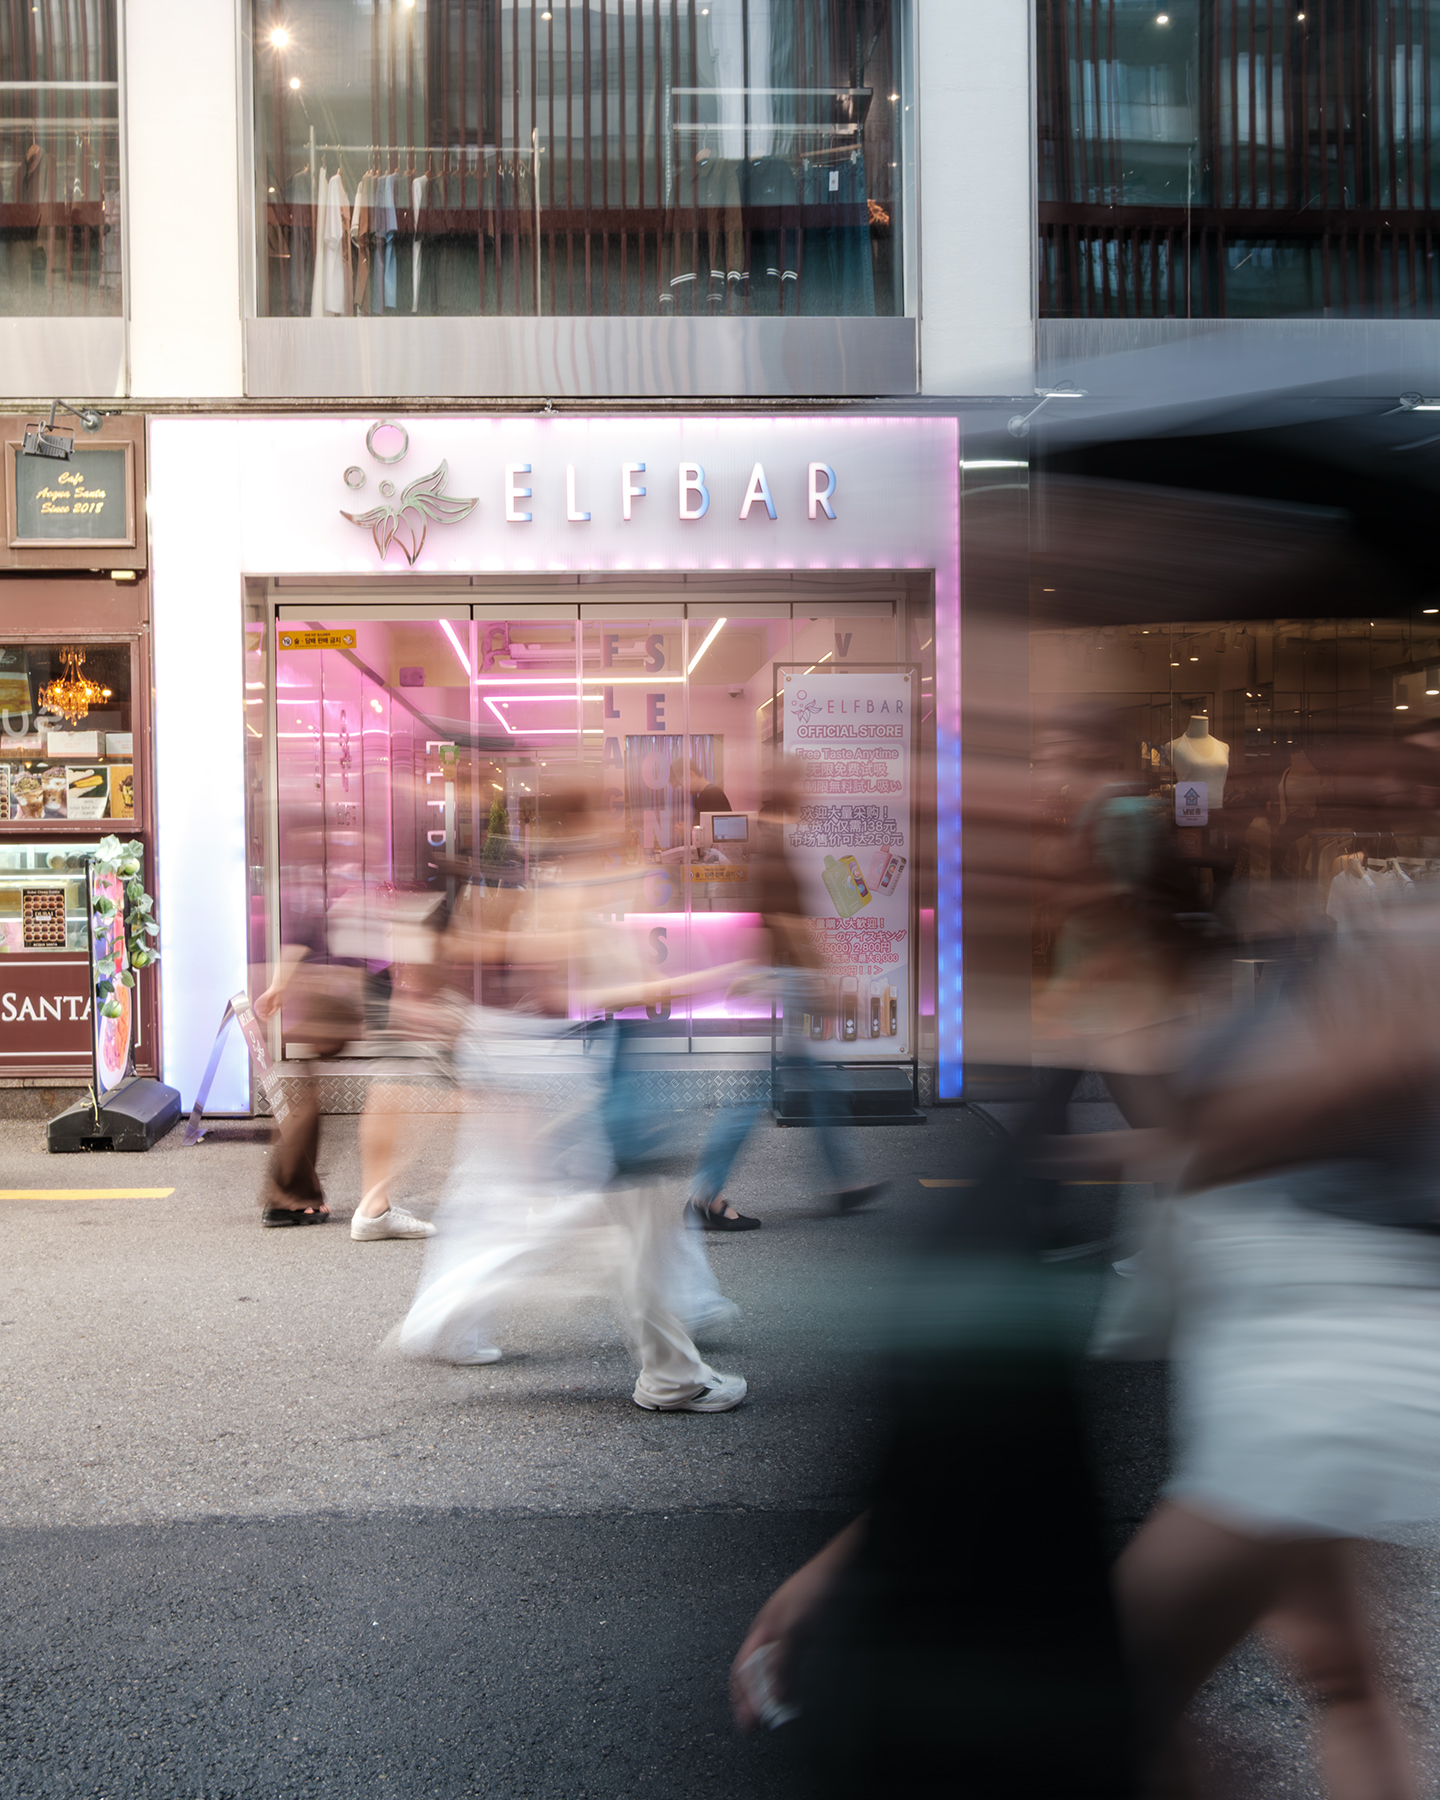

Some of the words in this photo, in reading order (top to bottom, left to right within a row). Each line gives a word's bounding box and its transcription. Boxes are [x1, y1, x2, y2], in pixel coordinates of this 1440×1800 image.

[58, 471, 84, 486] Cafe
[74, 486, 106, 499] Santa
[505, 462, 837, 522] ELFBAR
[41, 502, 70, 514] Since
[72, 501, 104, 514] 2018
[827, 699, 904, 714] ELFBAR
[797, 725, 857, 738] OFFICIAL
[858, 724, 903, 738] STORE
[796, 748, 822, 760] Free
[821, 748, 854, 760] Taste
[854, 747, 900, 763] Anytime
[806, 761, 889, 778] 无限免费试吸
[789, 832, 904, 847] 市场售价可达250元
